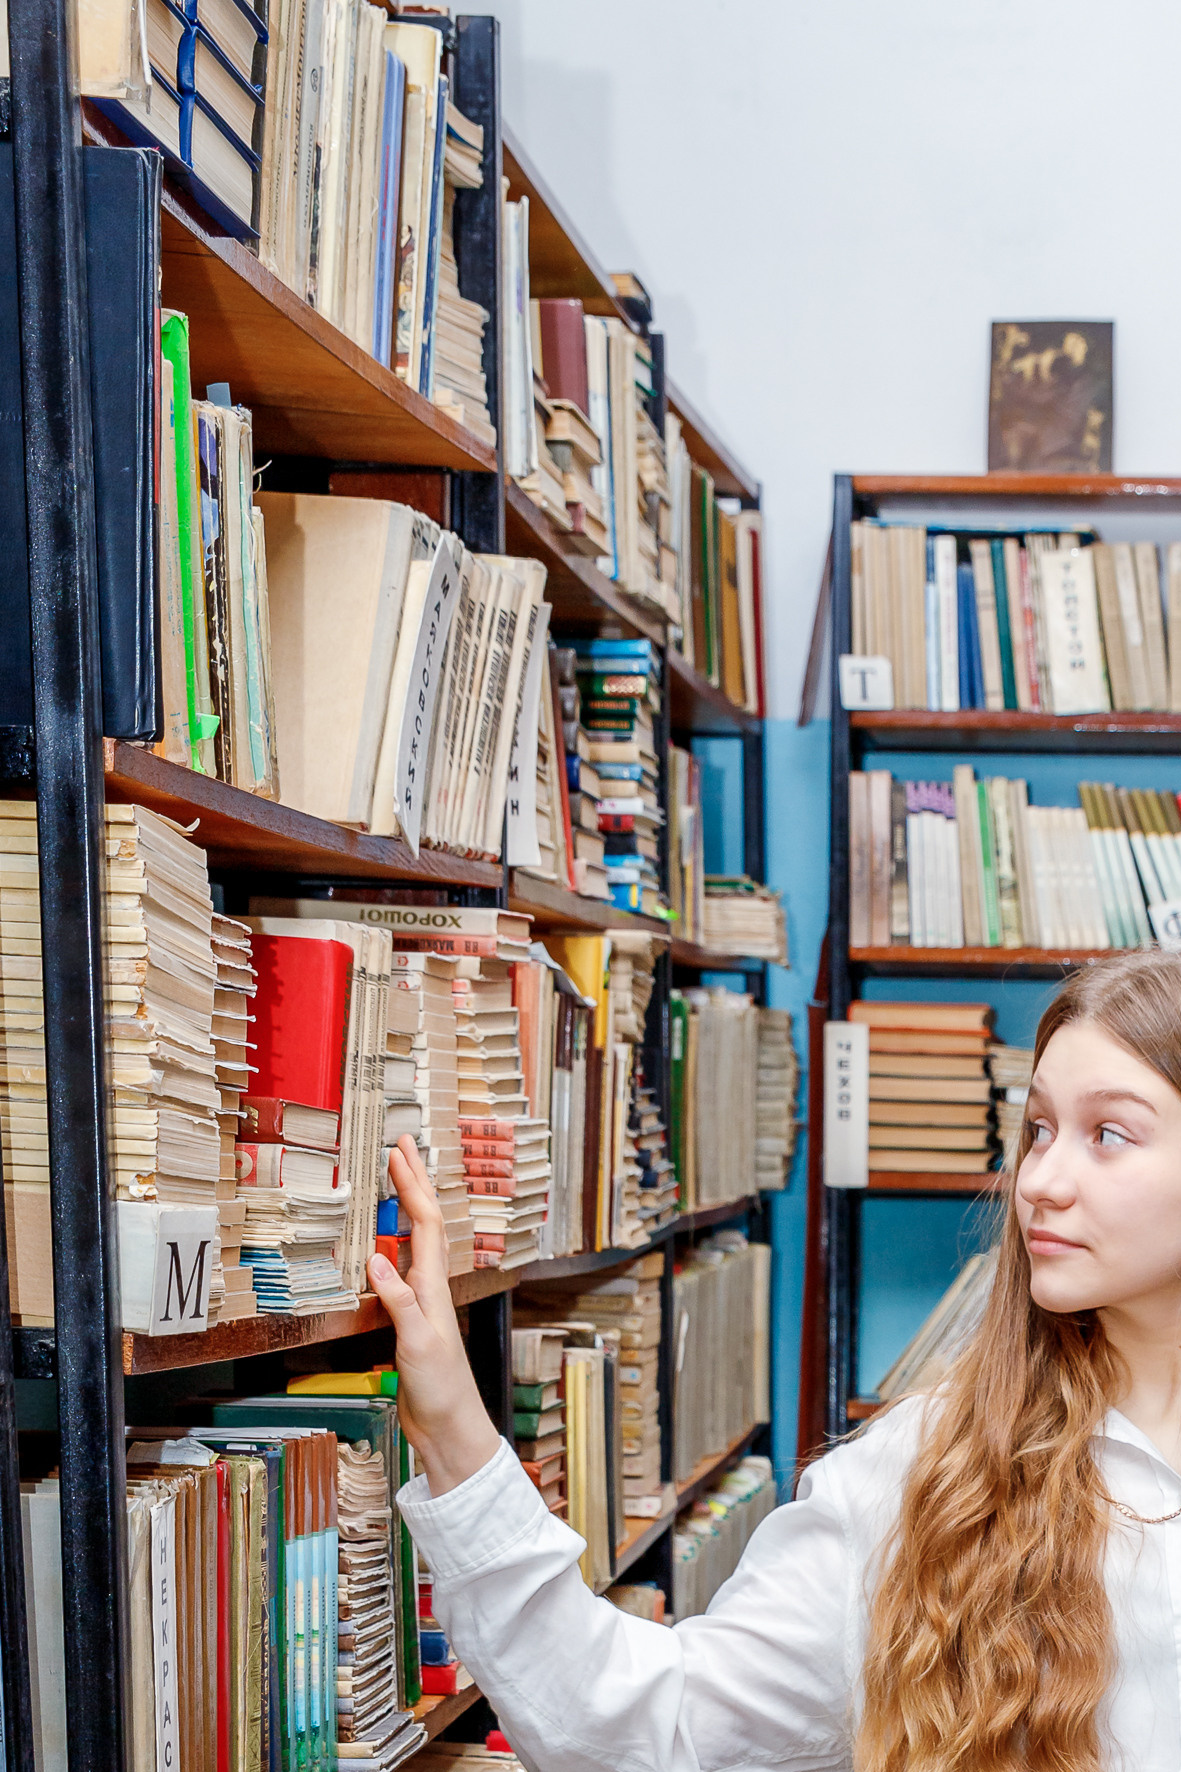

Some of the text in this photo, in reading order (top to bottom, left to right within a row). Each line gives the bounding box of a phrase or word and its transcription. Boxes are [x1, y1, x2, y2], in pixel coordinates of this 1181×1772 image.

[849, 667, 877, 703] Т
[359, 908, 463, 929] ХОРОШО!
[158, 1240, 211, 1323] М
